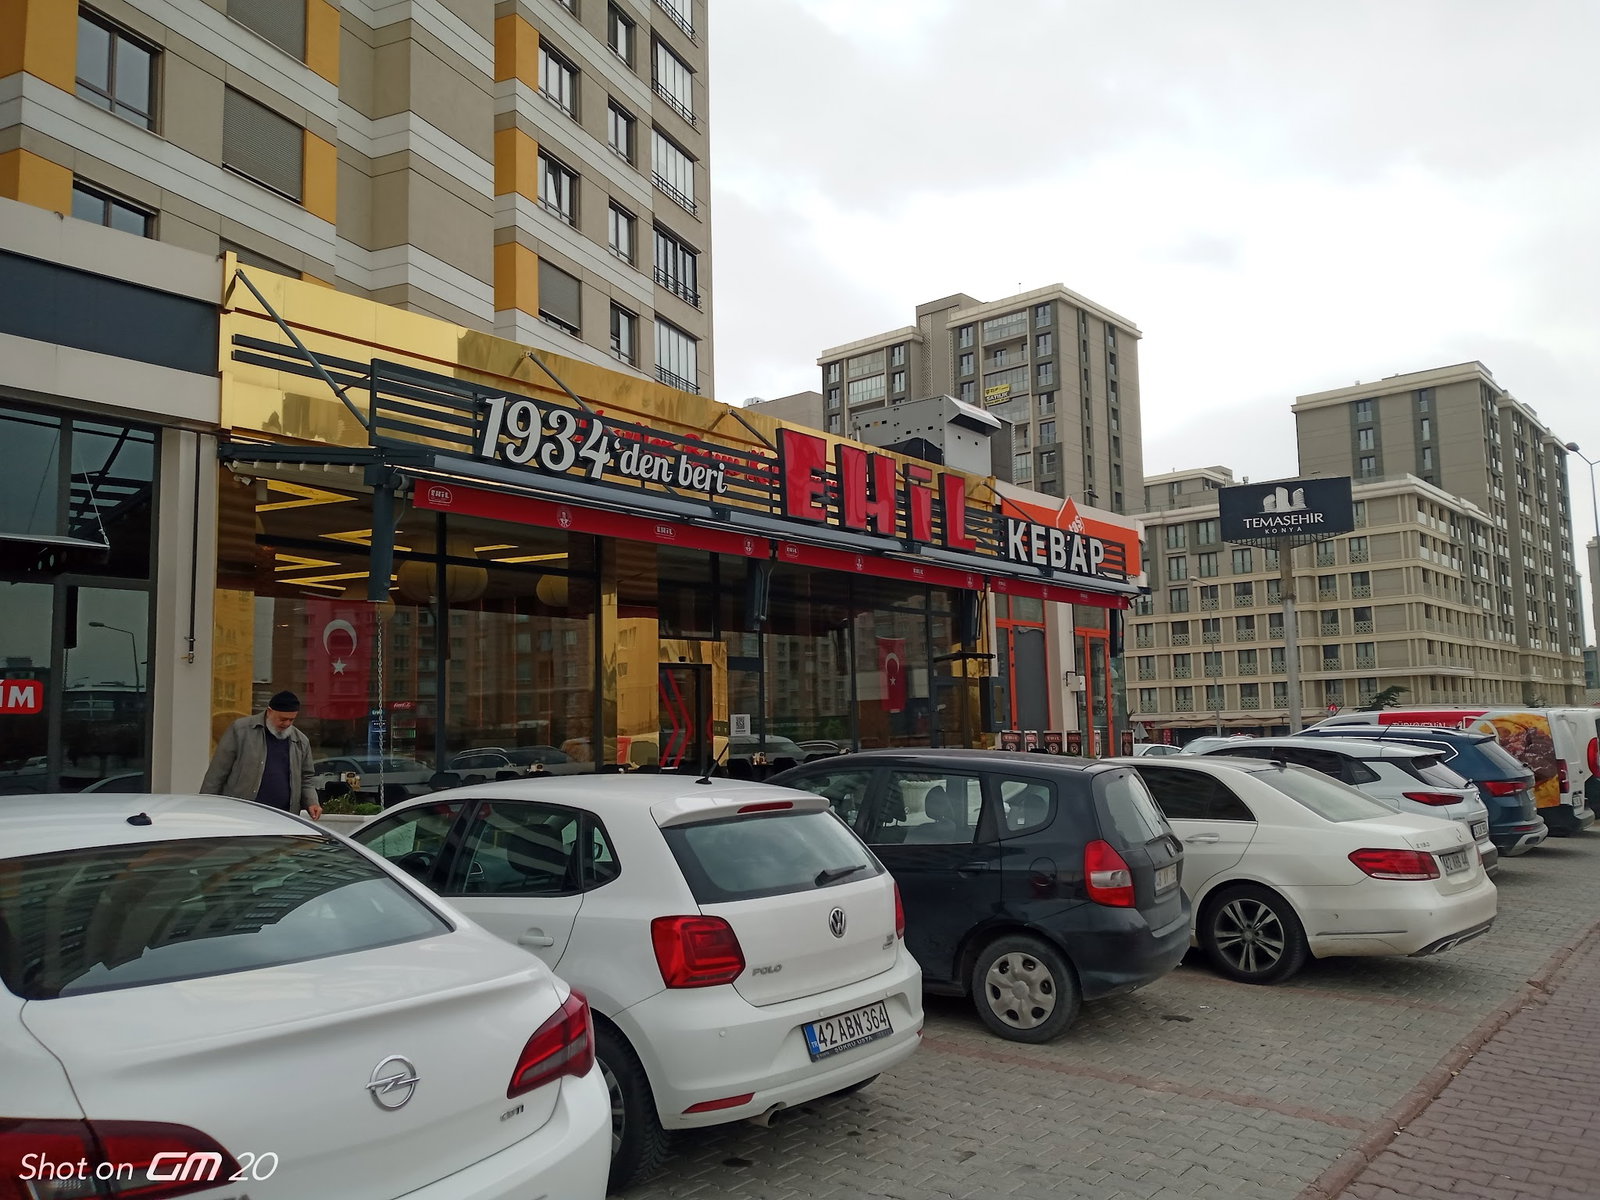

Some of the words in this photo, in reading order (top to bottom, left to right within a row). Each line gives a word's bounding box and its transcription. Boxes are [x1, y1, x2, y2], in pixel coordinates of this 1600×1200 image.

[678, 454, 728, 494] beri
[1008, 518, 1105, 575] KEBAP
[1264, 526, 1303, 535] KONYA
[751, 963, 783, 977] POLO
[819, 1026, 837, 1046] 42
[838, 1015, 863, 1040] ABN
[863, 1007, 886, 1031] 364
